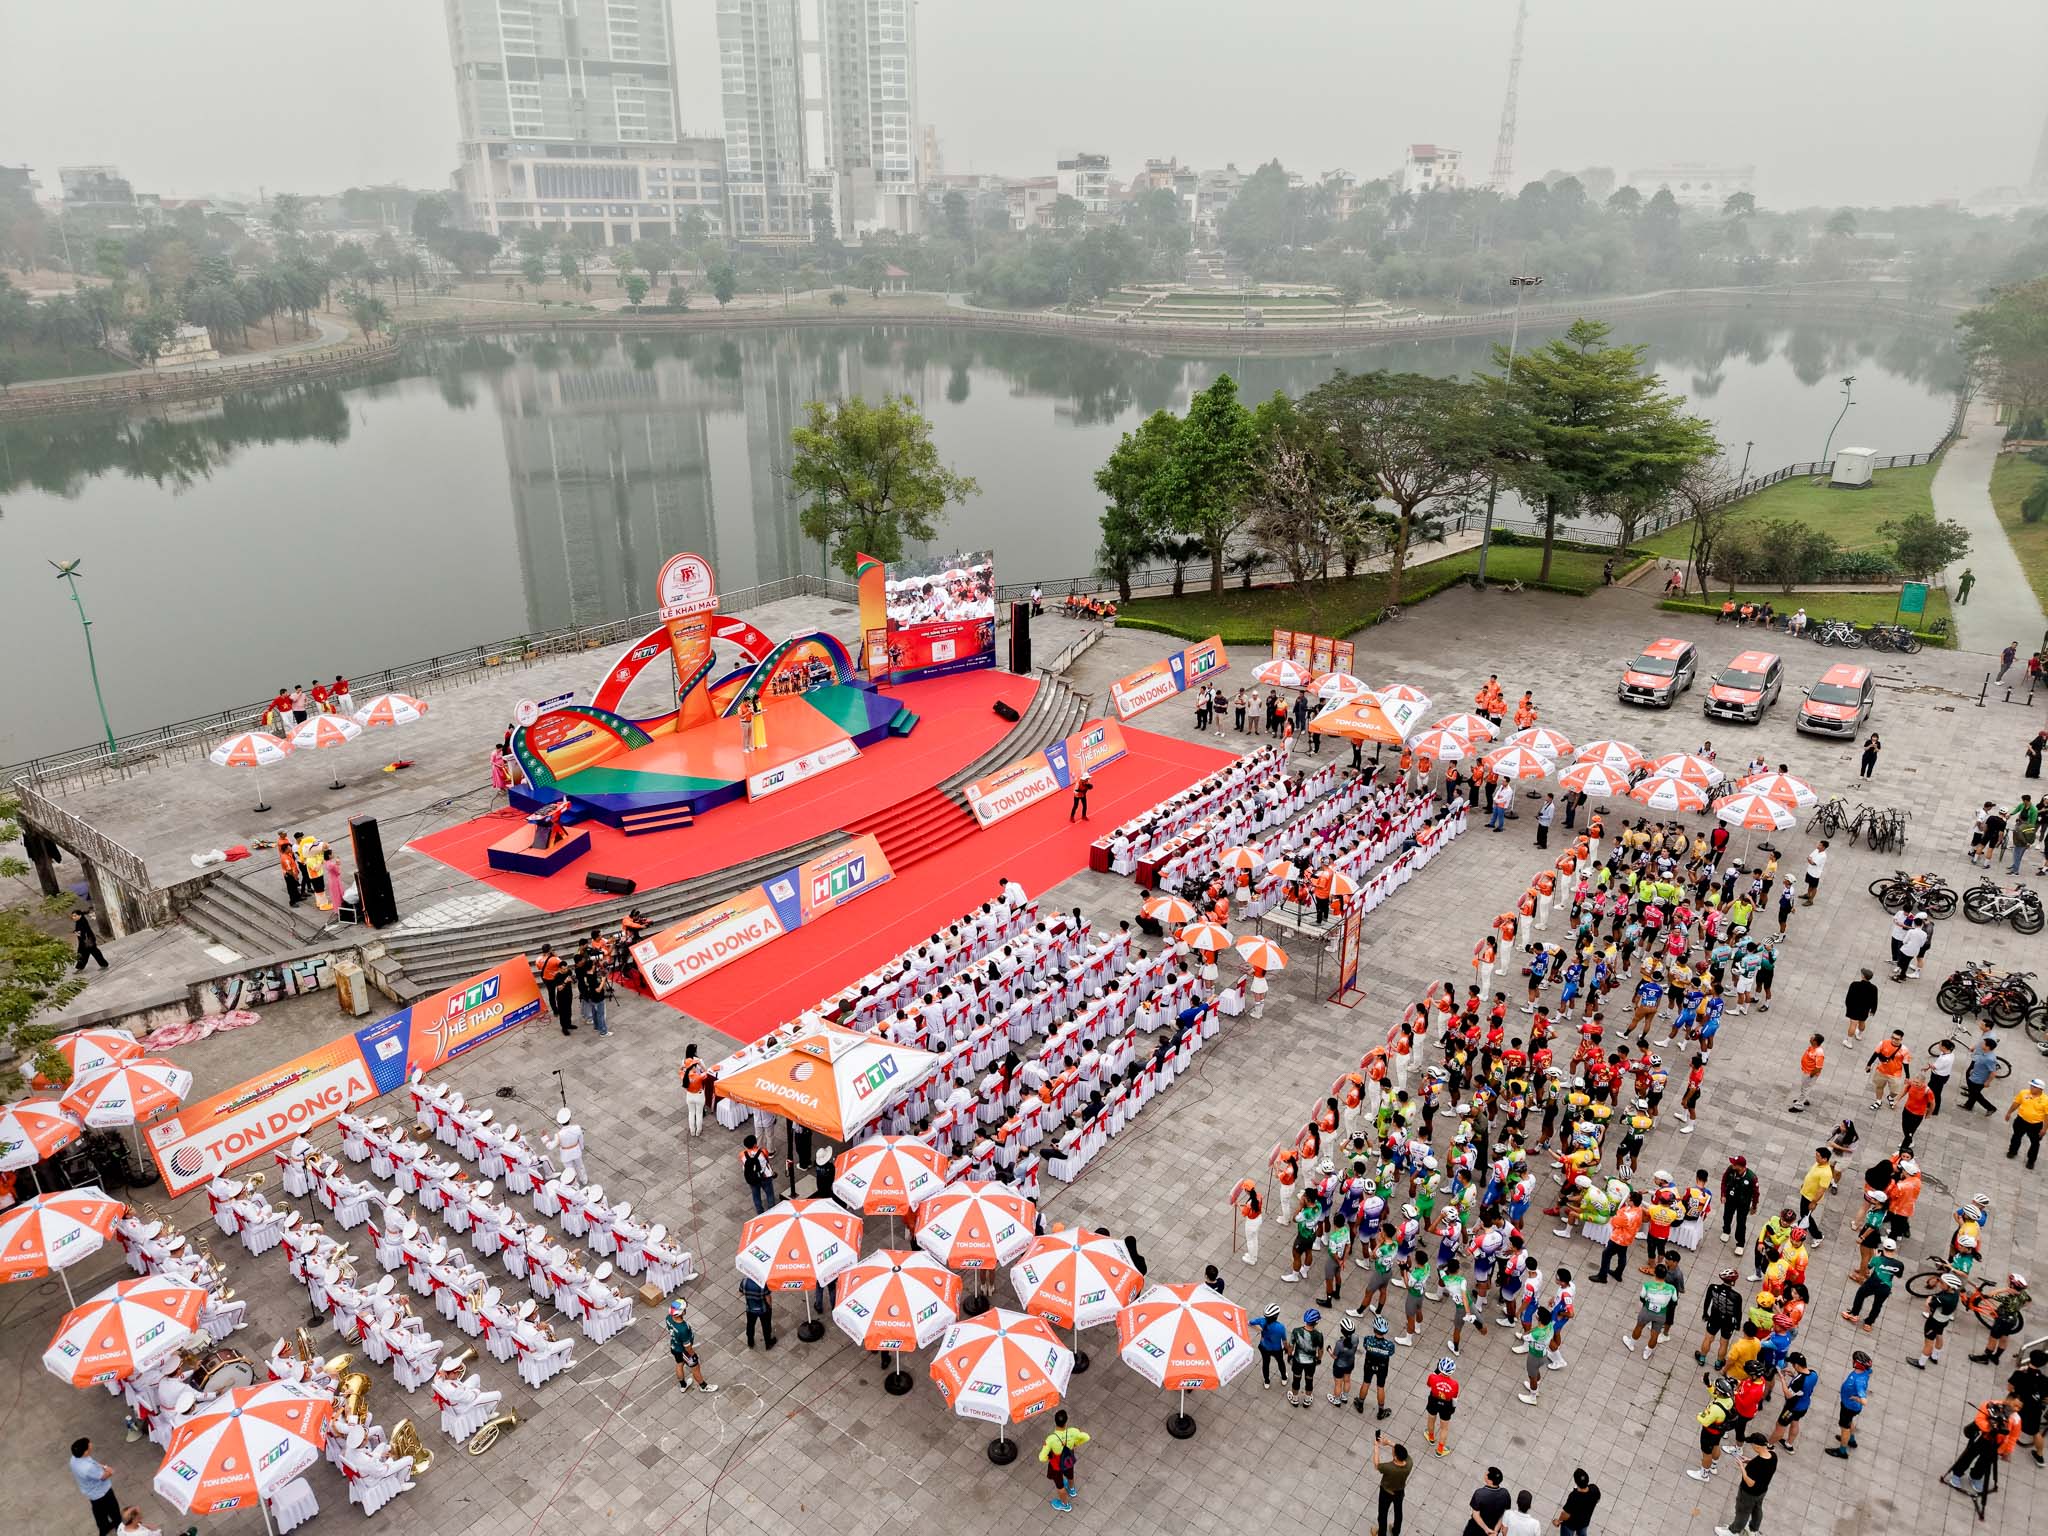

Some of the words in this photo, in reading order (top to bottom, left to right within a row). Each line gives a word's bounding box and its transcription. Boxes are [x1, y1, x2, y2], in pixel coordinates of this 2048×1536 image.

[676, 604, 696, 615] KHAI
[632, 644, 658, 660] HTV
[1190, 650, 1216, 677] HTV
[1128, 693, 1147, 708] TON
[1147, 686, 1167, 702] DONG
[1167, 681, 1174, 690] A
[1082, 728, 1104, 749] HTV
[762, 770, 784, 788] HTV
[992, 796, 1016, 814] TON
[1016, 782, 1046, 801] DONG
[1046, 776, 1055, 788] A
[812, 856, 866, 908] HTV
[674, 946, 714, 976] TON
[712, 924, 762, 958] DONG
[763, 918, 777, 934] A
[448, 975, 500, 1019] HTV
[470, 1002, 504, 1027] THAO
[79, 1058, 104, 1072] HTV
[853, 1054, 898, 1100] HTV
[755, 1078, 776, 1094] TON
[776, 1085, 808, 1104] DONG
[810, 1098, 819, 1108] A
[96, 1100, 126, 1108] HTV
[149, 1104, 167, 1116] HTV
[206, 1122, 266, 1162] TON
[267, 1086, 343, 1134] DONG
[348, 1077, 366, 1098] A
[845, 1173, 867, 1188] HTV
[910, 1173, 928, 1190] HTV
[53, 1228, 80, 1250] HTV
[928, 1224, 952, 1240] HTV
[996, 1224, 1015, 1243] HTV
[748, 1246, 771, 1262] HTV
[816, 1242, 838, 1264] HTV
[10, 1270, 34, 1280] HTV
[1023, 1264, 1039, 1284] HTV
[1039, 1290, 1051, 1299] TON
[1051, 1293, 1067, 1305] DONG
[1080, 1289, 1105, 1305] HTV
[845, 1299, 869, 1317] HTV
[917, 1302, 938, 1324] HTV
[1040, 1311, 1062, 1322] HTV
[136, 1322, 165, 1348] HTV
[879, 1340, 903, 1348] HTV
[58, 1340, 80, 1357] HTV
[1136, 1338, 1165, 1358] HTV
[1215, 1337, 1235, 1360] HTV
[1045, 1348, 1058, 1376] HTV
[90, 1370, 118, 1384] HTV
[968, 1381, 1002, 1396] HTV
[1011, 1388, 1024, 1397] TON
[1024, 1381, 1040, 1392] DONG
[1024, 1401, 1044, 1417] HTV
[259, 1438, 289, 1471] HTV
[171, 1460, 198, 1480] HTV
[276, 1476, 289, 1486] TON
[288, 1463, 305, 1478] DONG
[203, 1479, 219, 1488] TON
[219, 1475, 241, 1485] DONG
[209, 1497, 240, 1512] HTV
